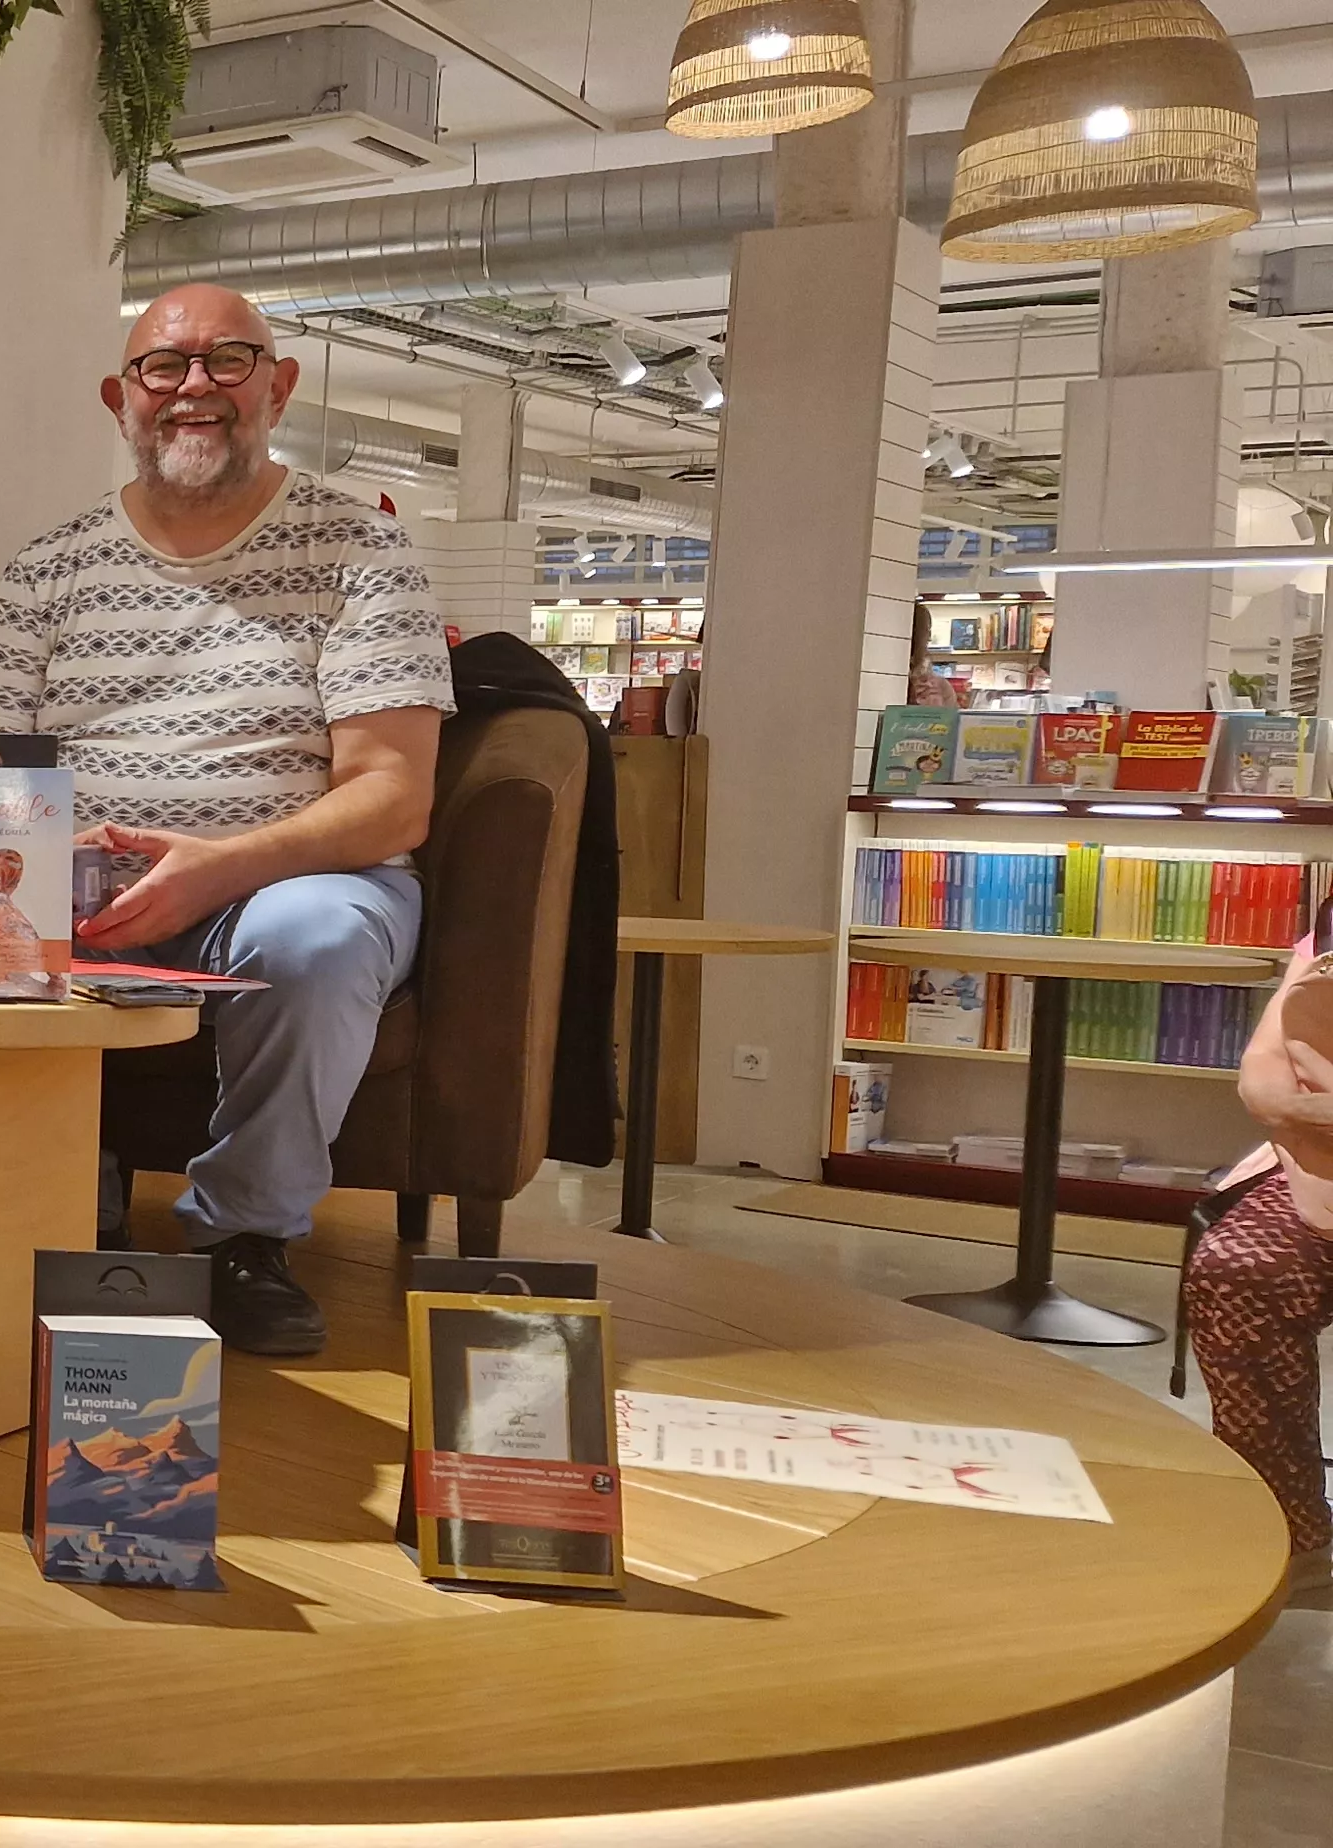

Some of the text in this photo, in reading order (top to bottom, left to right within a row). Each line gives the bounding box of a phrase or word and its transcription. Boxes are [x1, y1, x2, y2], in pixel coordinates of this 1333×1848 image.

[1137, 724, 1152, 732] La
[1154, 724, 1187, 733] Biblia
[1247, 729, 1298, 742] TREBEP
[64, 1366, 128, 1381] THOMAS
[64, 1380, 112, 1394] MANN
[63, 1394, 138, 1411] La montaña
[63, 1409, 107, 1425] mágica
